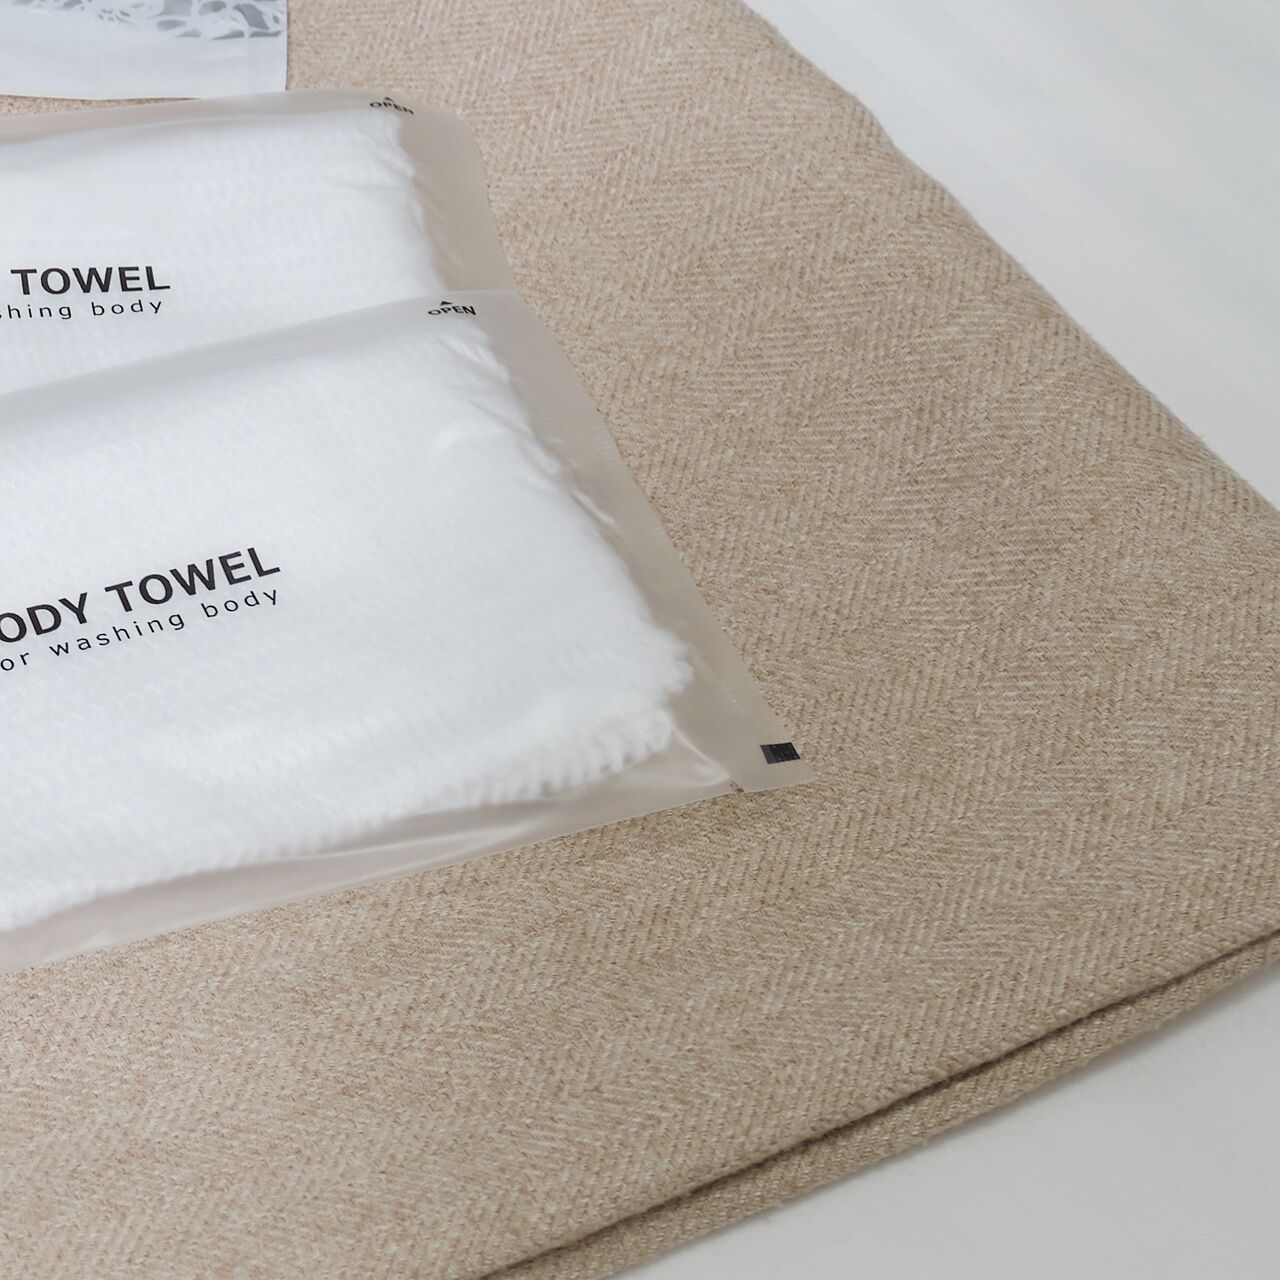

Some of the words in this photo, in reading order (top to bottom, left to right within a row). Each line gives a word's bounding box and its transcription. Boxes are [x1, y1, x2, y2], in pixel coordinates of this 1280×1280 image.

[369, 101, 415, 115] OPEN
[10, 265, 172, 296] TOWEL
[90, 298, 164, 317] body
[427, 305, 477, 317] OPEN
[104, 546, 282, 614] TOWEL
[48, 611, 186, 658] washing
[201, 588, 279, 619] body
